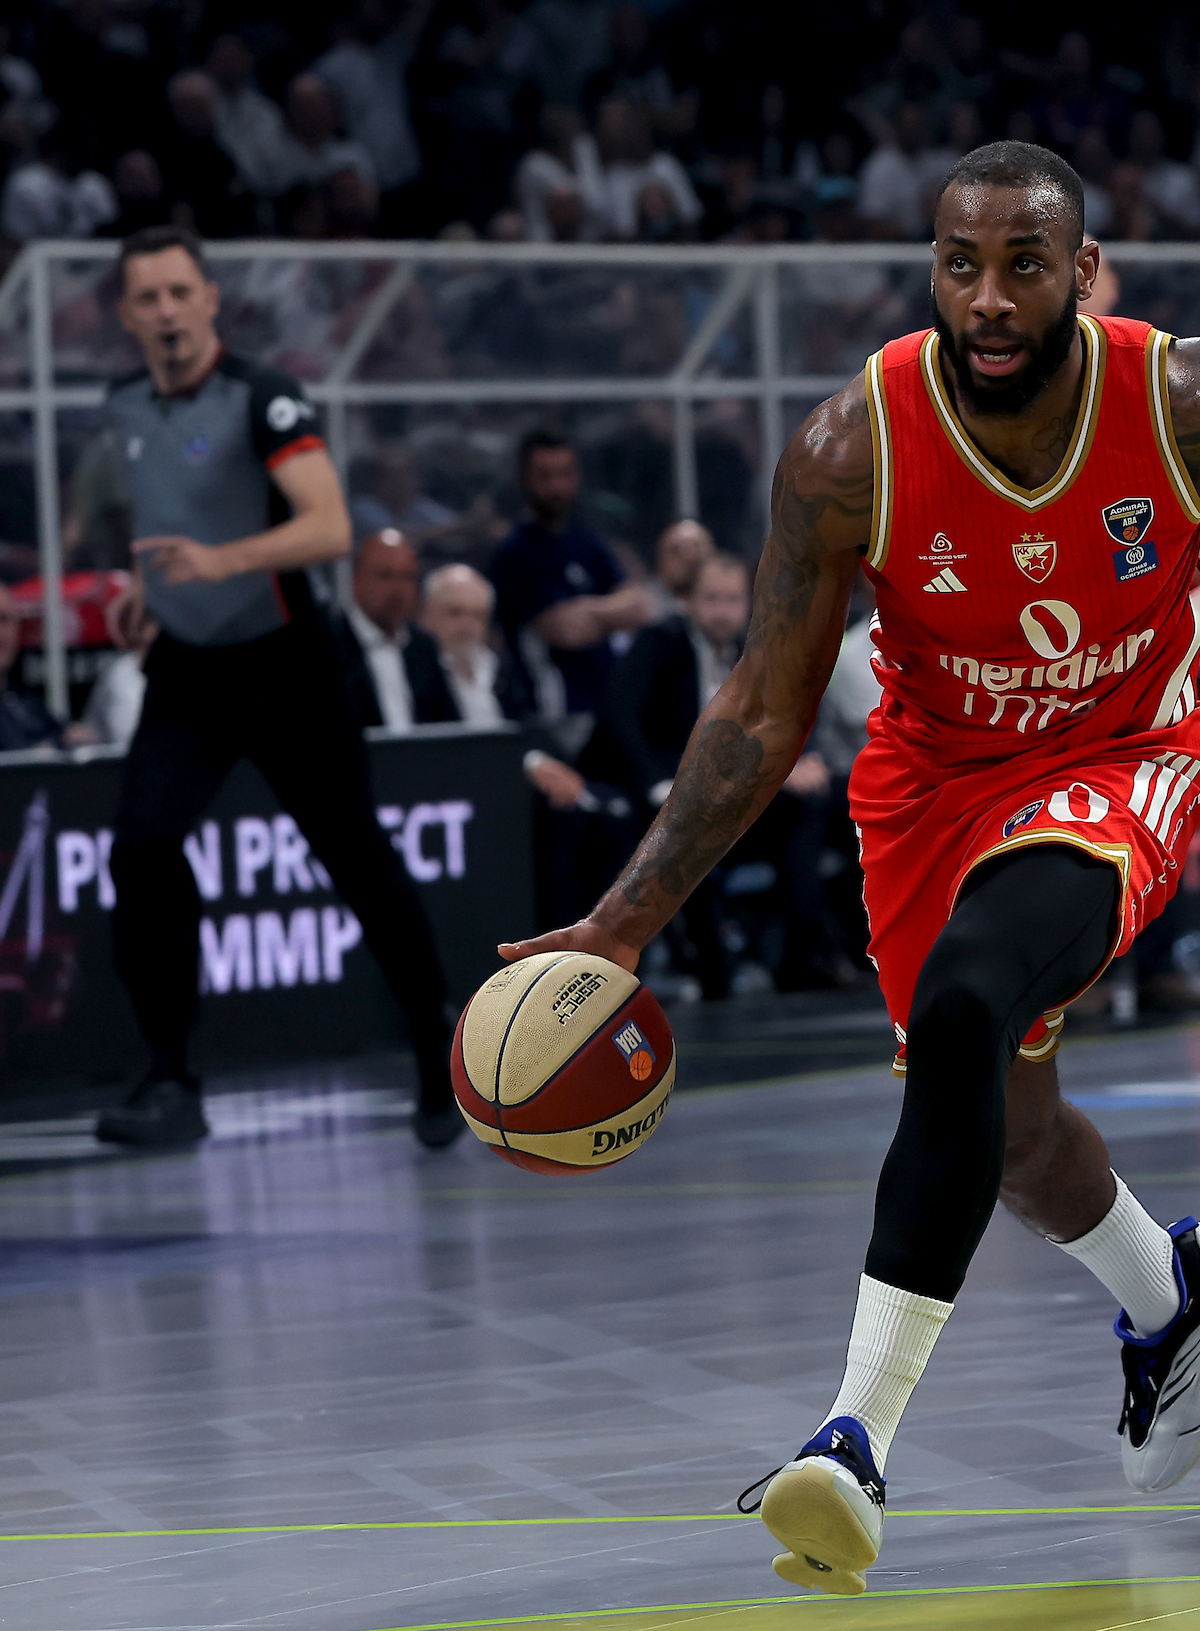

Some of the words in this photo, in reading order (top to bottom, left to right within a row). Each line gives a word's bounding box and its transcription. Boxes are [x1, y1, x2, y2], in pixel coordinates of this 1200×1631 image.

[1109, 501, 1148, 515] ADMIRAL
[1122, 516, 1138, 527] ABA
[1128, 562, 1148, 574] ДУНАВ
[1019, 599, 1081, 660] 0
[234, 801, 474, 894] PRCT
[198, 905, 364, 995] MMP
[558, 973, 609, 1025] LEGACY
[615, 1022, 642, 1055] ABA
[592, 1093, 669, 1156] LDING
